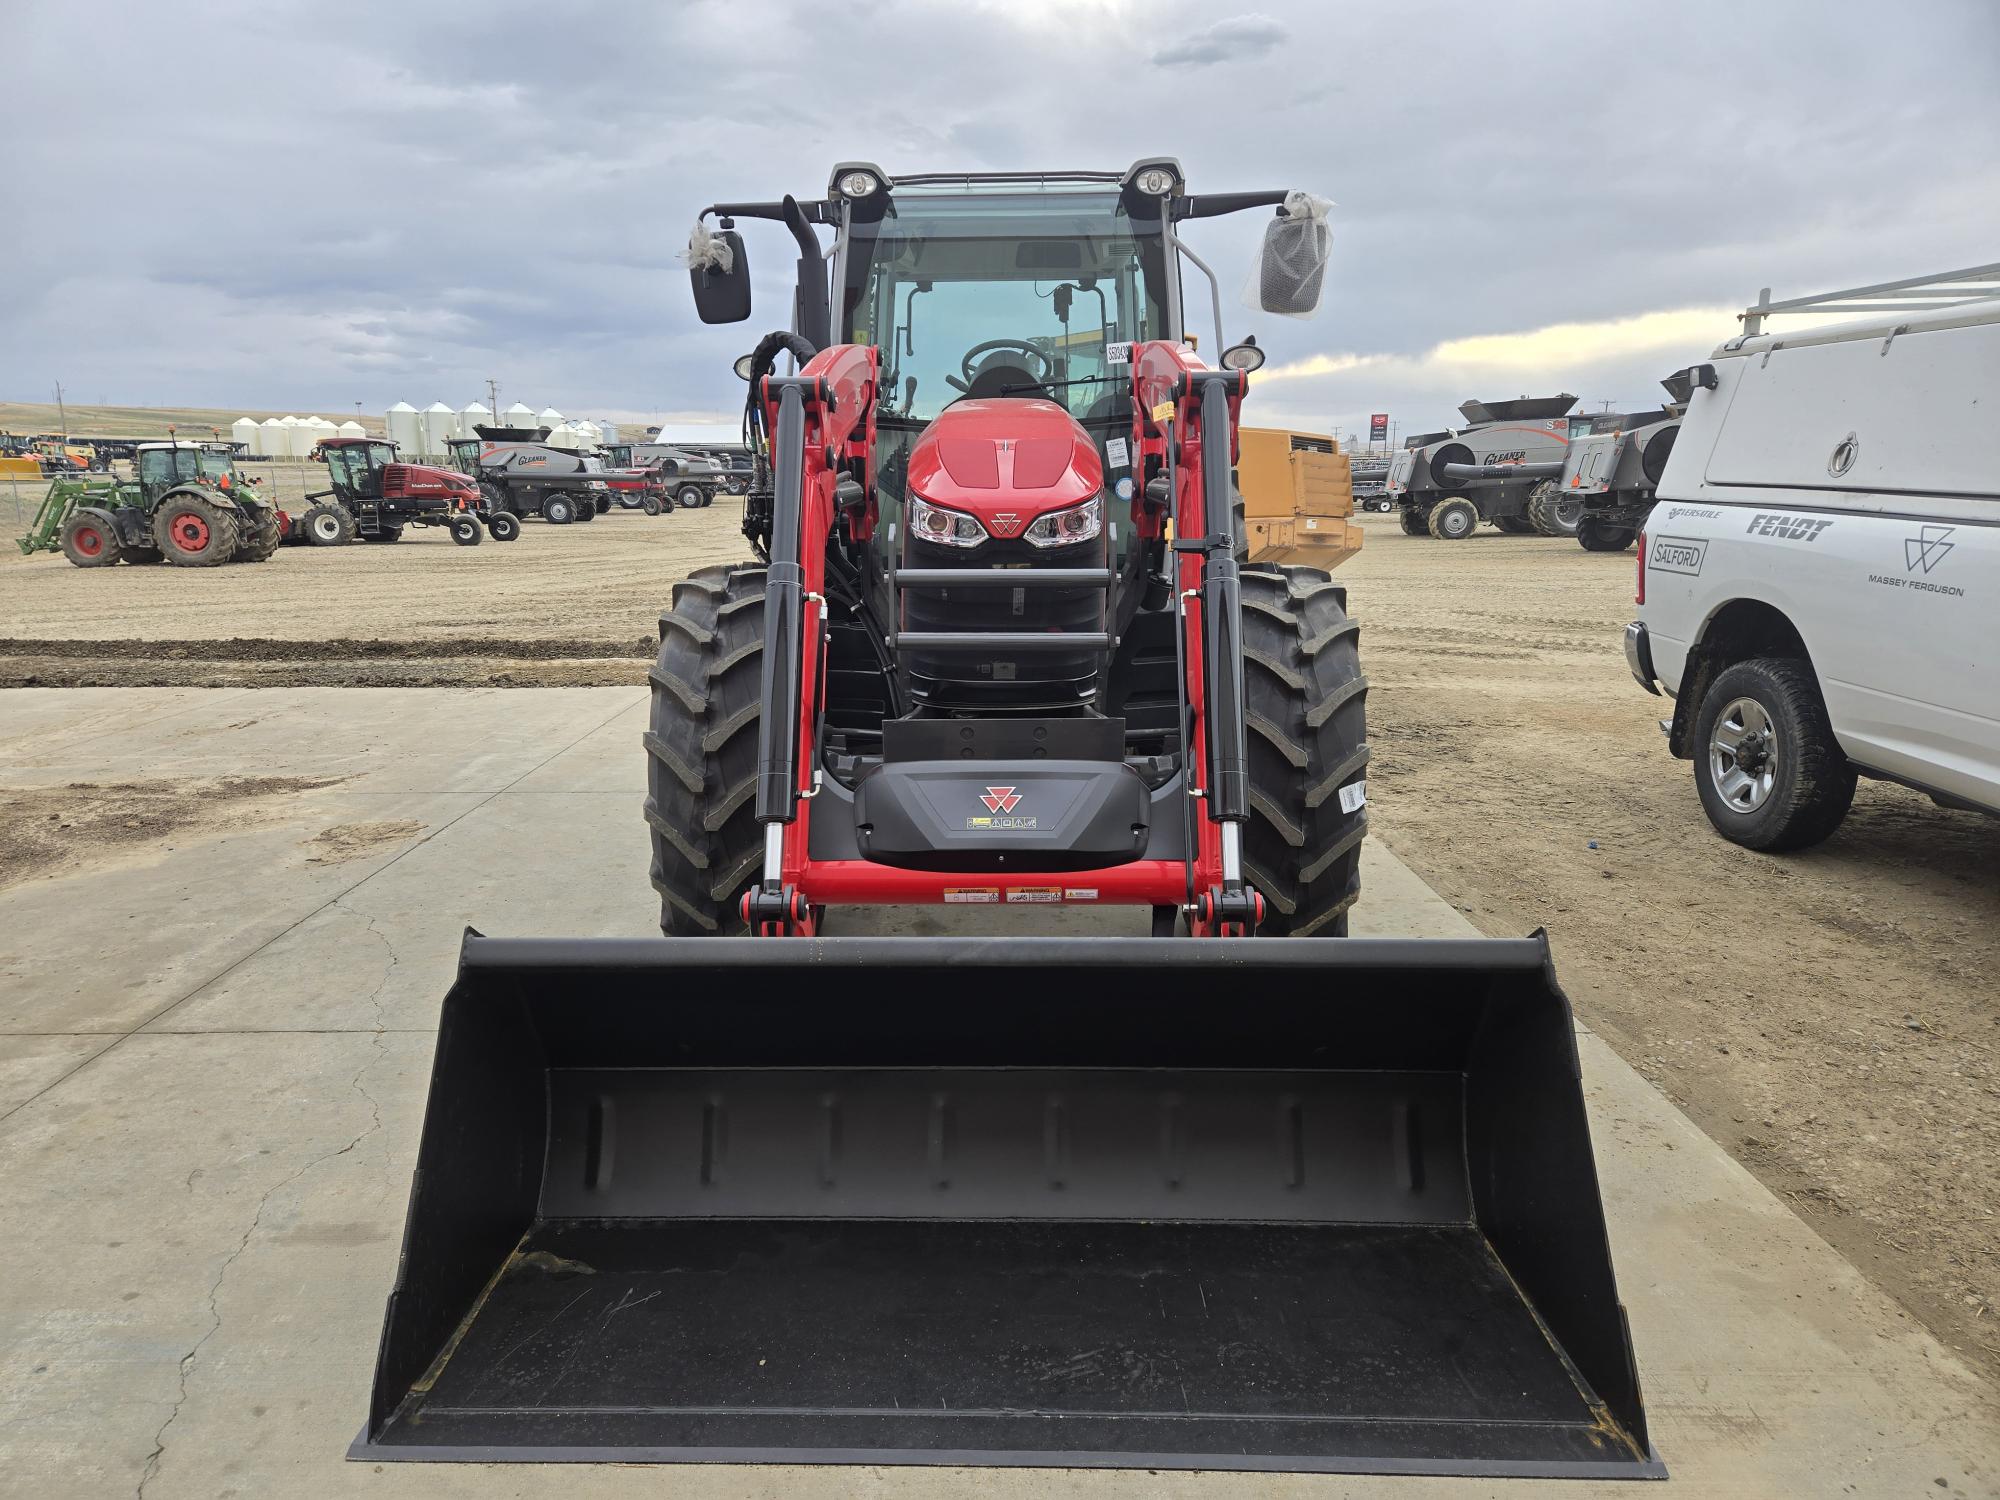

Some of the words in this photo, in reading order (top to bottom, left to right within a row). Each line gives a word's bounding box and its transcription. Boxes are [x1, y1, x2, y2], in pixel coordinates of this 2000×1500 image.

[518, 455, 547, 466] GLEANER
[1484, 451, 1526, 466] GLEANER
[1746, 514, 1835, 542] FENDT
[1654, 543, 1700, 567] SALFORD
[1868, 574, 1907, 588] MASSEY
[1908, 580, 1965, 597] FERGUSON
